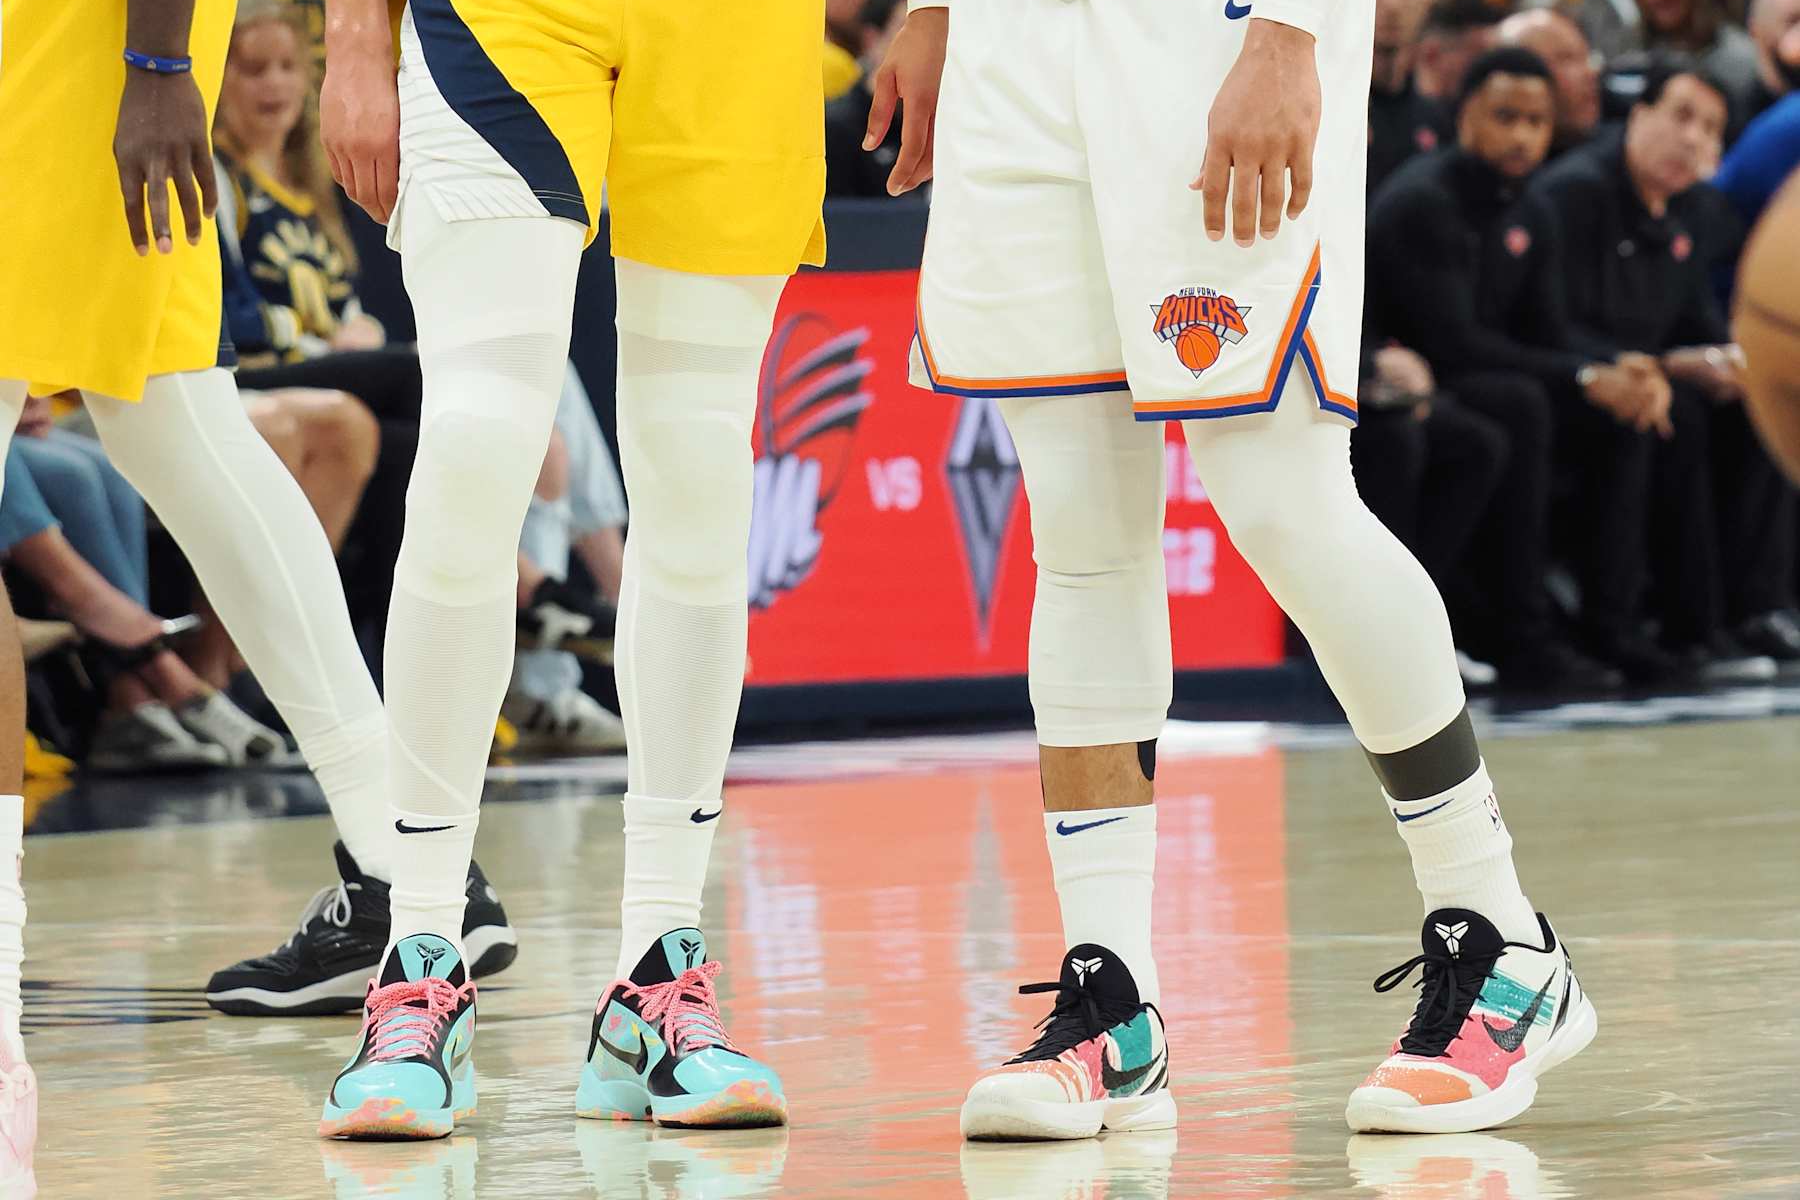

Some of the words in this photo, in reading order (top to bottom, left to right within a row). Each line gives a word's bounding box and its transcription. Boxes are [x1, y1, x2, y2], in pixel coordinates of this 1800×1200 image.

[1179, 287, 1195, 296] NEW
[1197, 287, 1217, 297] YORK
[1153, 294, 1248, 340] KNICKS
[865, 455, 923, 511] VS
